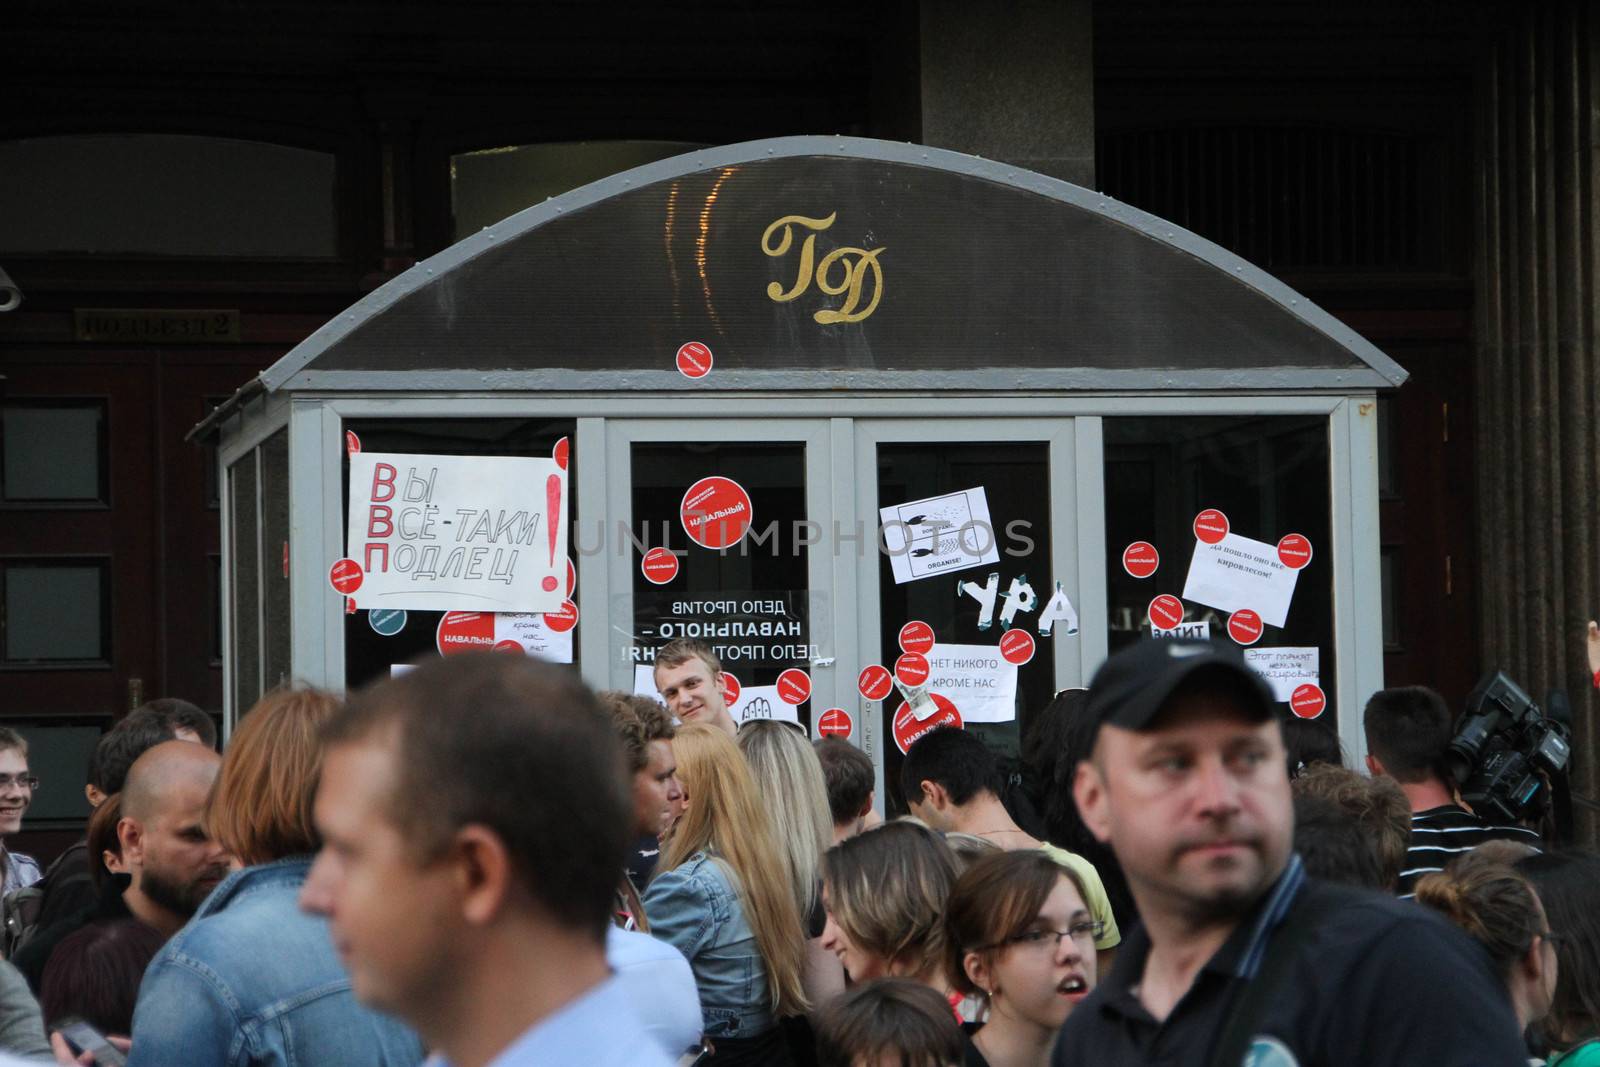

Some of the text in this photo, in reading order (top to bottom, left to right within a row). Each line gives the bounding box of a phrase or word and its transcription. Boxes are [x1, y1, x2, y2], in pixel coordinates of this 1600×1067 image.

[213, 313, 230, 336] 2
[689, 501, 745, 529] НАВАЛЬНЫЙ
[1223, 546, 1252, 560] пошло
[1253, 556, 1270, 565] оно
[958, 572, 1079, 637] УРА
[930, 659, 950, 669] НЕТ
[953, 659, 998, 669] НИКОГО
[932, 678, 996, 688] КРОМЕ НАС
[903, 712, 956, 746] НАВАЛЫЙ
